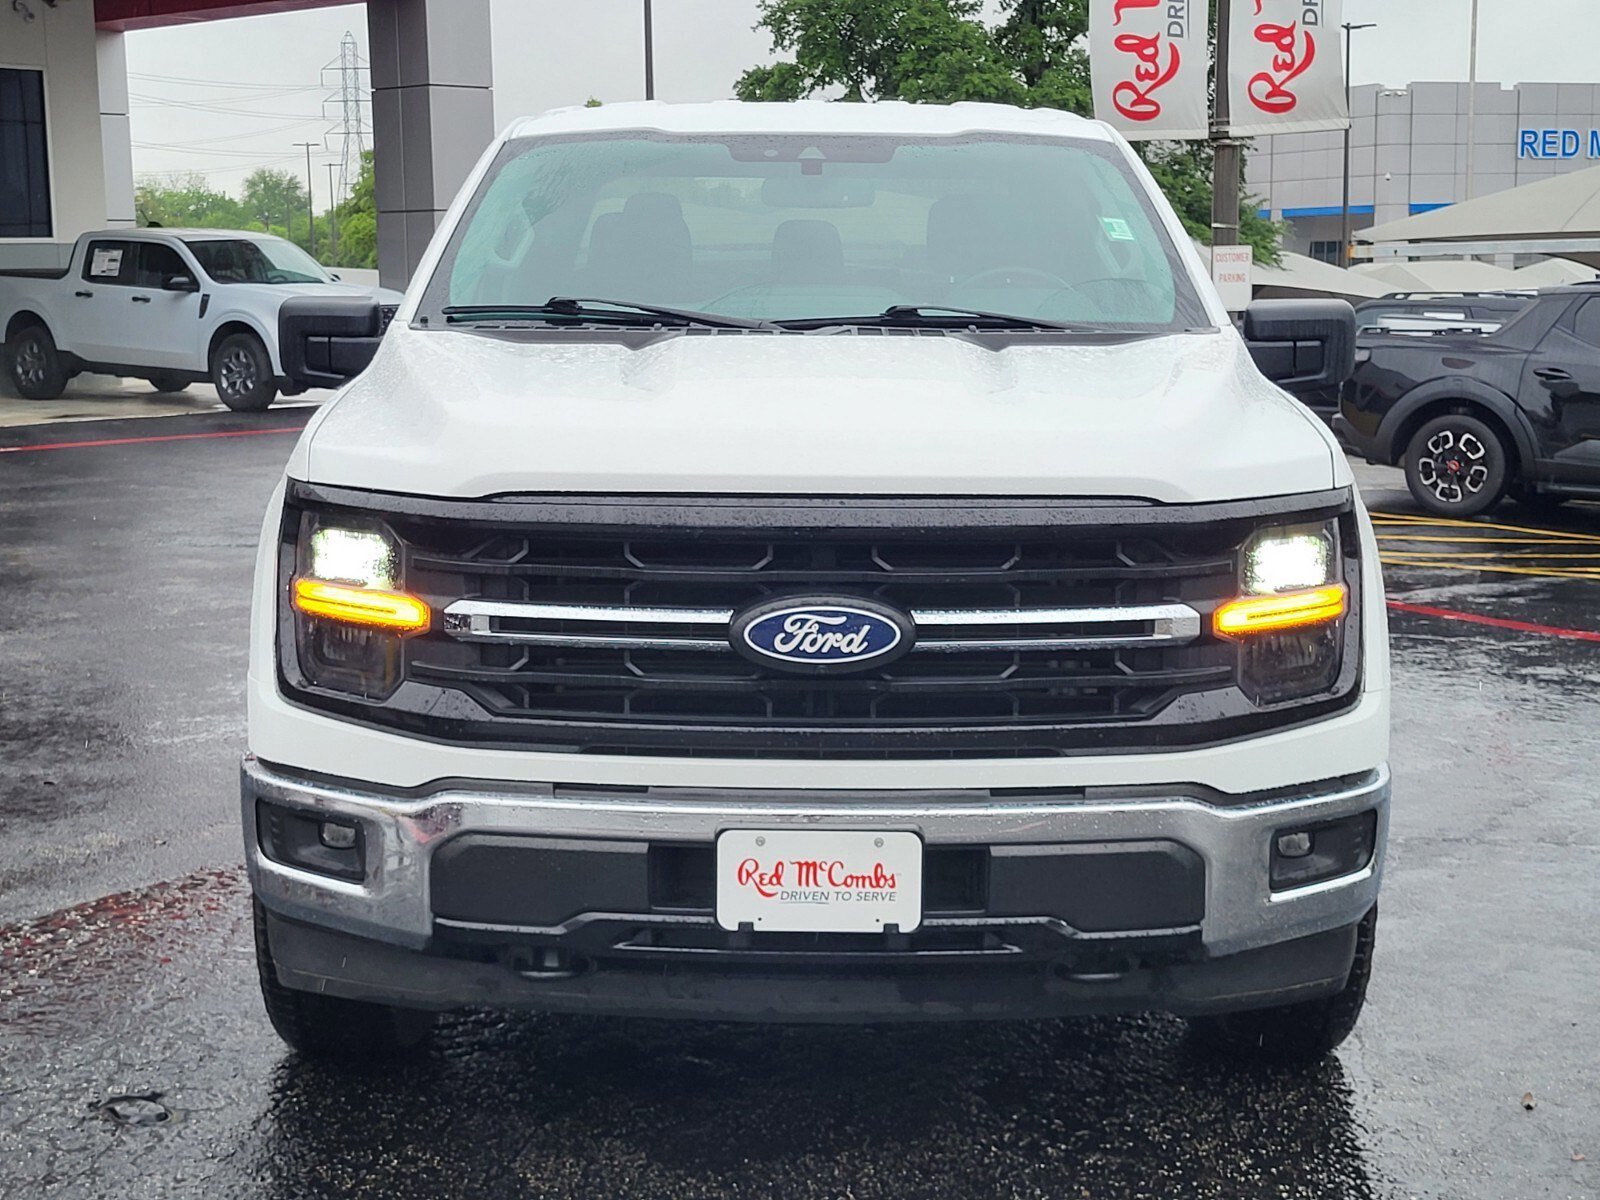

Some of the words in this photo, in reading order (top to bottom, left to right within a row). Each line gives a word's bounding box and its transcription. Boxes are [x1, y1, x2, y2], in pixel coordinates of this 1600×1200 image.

[1112, 32, 1180, 122] Red
[1247, 20, 1316, 114] Red
[1519, 129, 1580, 158] RED
[1215, 252, 1249, 263] CUSTOMER
[1219, 272, 1246, 283] PARKING
[774, 613, 871, 654] Ford
[737, 858, 784, 898] Red
[789, 860, 897, 889] McCombs
[780, 890, 830, 902] DRIVEN
[834, 890, 852, 902] TO
[856, 891, 897, 902] SERVE
